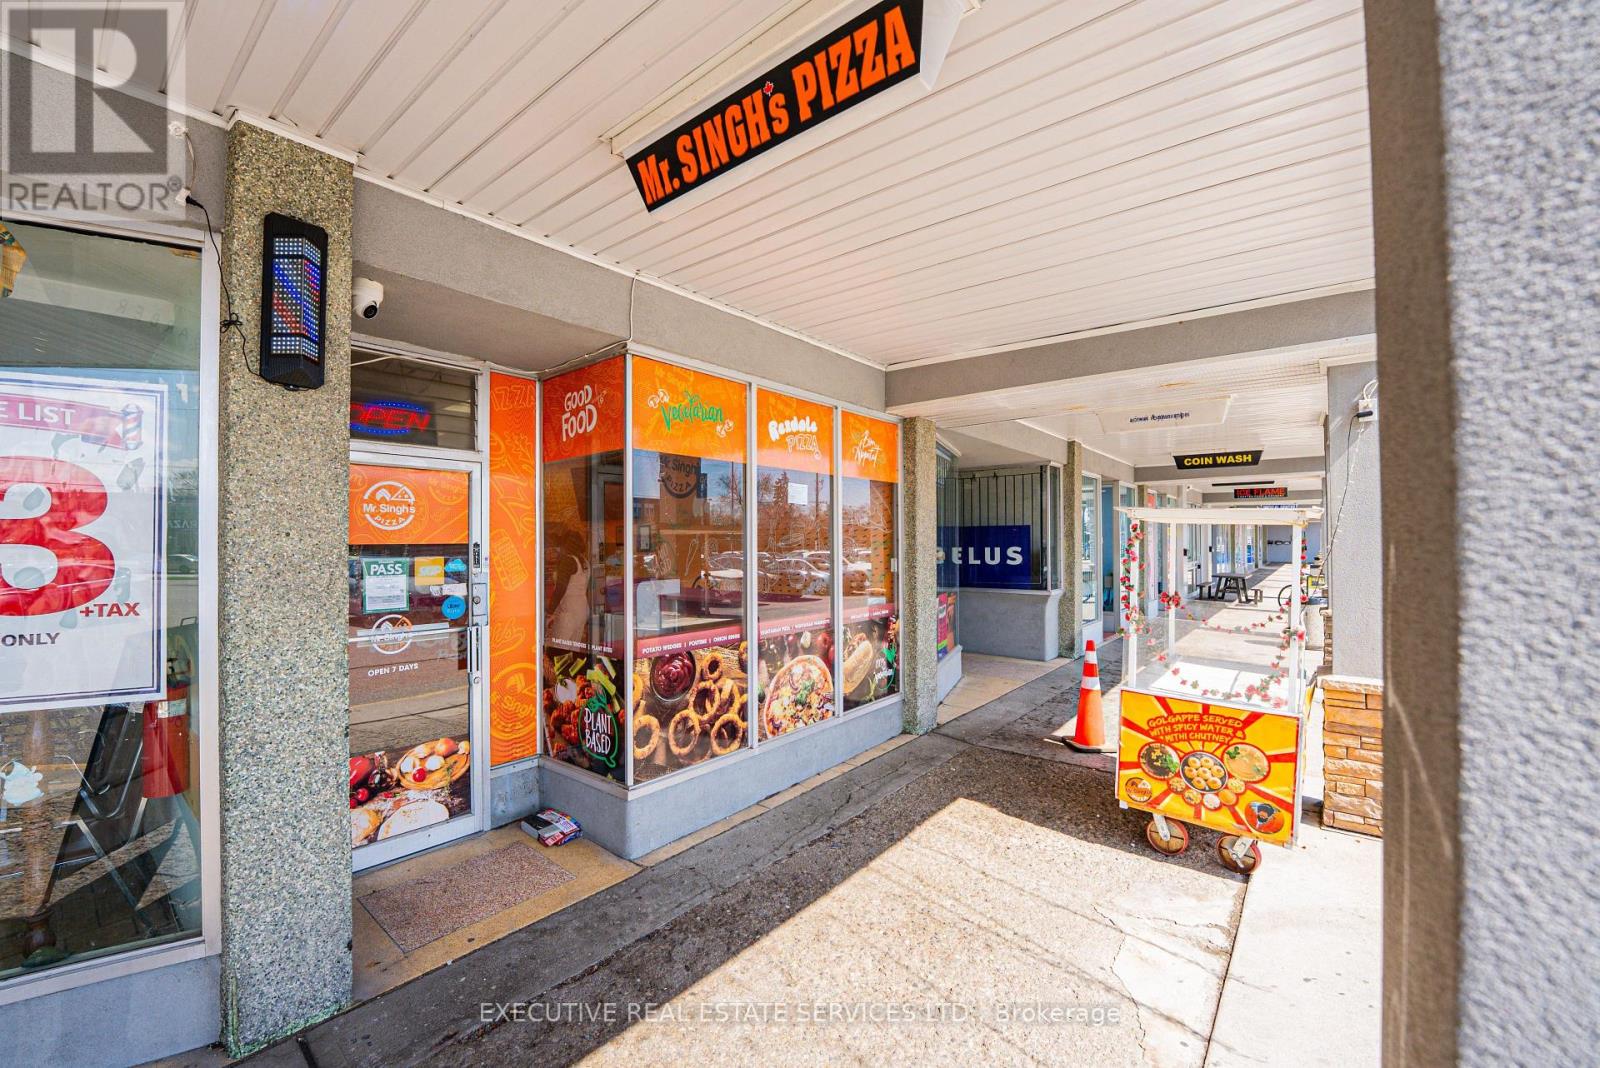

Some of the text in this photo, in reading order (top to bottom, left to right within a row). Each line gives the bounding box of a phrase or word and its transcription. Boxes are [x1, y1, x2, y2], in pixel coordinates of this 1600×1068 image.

[637, 153, 681, 205] Mr.
[791, 5, 916, 123] PIZZA
[564, 384, 593, 412] GOOD
[18, 402, 76, 425] LIST
[562, 404, 598, 442] FOOD
[786, 433, 821, 457] PIZZA
[1184, 454, 1252, 466] COIN WASH
[1254, 487, 1285, 496] FLAME
[363, 503, 376, 513] Mr.
[374, 515, 406, 527] PIZZA
[370, 563, 403, 575] PASS
[80, 602, 140, 618] +TAX
[1, 632, 61, 647] ONLY
[642, 646, 662, 655] POTATO
[663, 642, 682, 651] WEDGES
[689, 638, 707, 647] POUTINE
[368, 667, 390, 677] OPEN
[398, 663, 419, 672] DAYS
[584, 707, 612, 735] PLANT
[1149, 714, 1243, 728] GOLGAPPE SERVED
[1150, 725, 1171, 736] WITH
[1174, 723, 1197, 732] SPICY
[1200, 724, 1234, 735] WATER
[585, 728, 611, 755] BASED
[1166, 732, 1230, 744] MITHI CHUTNEY
